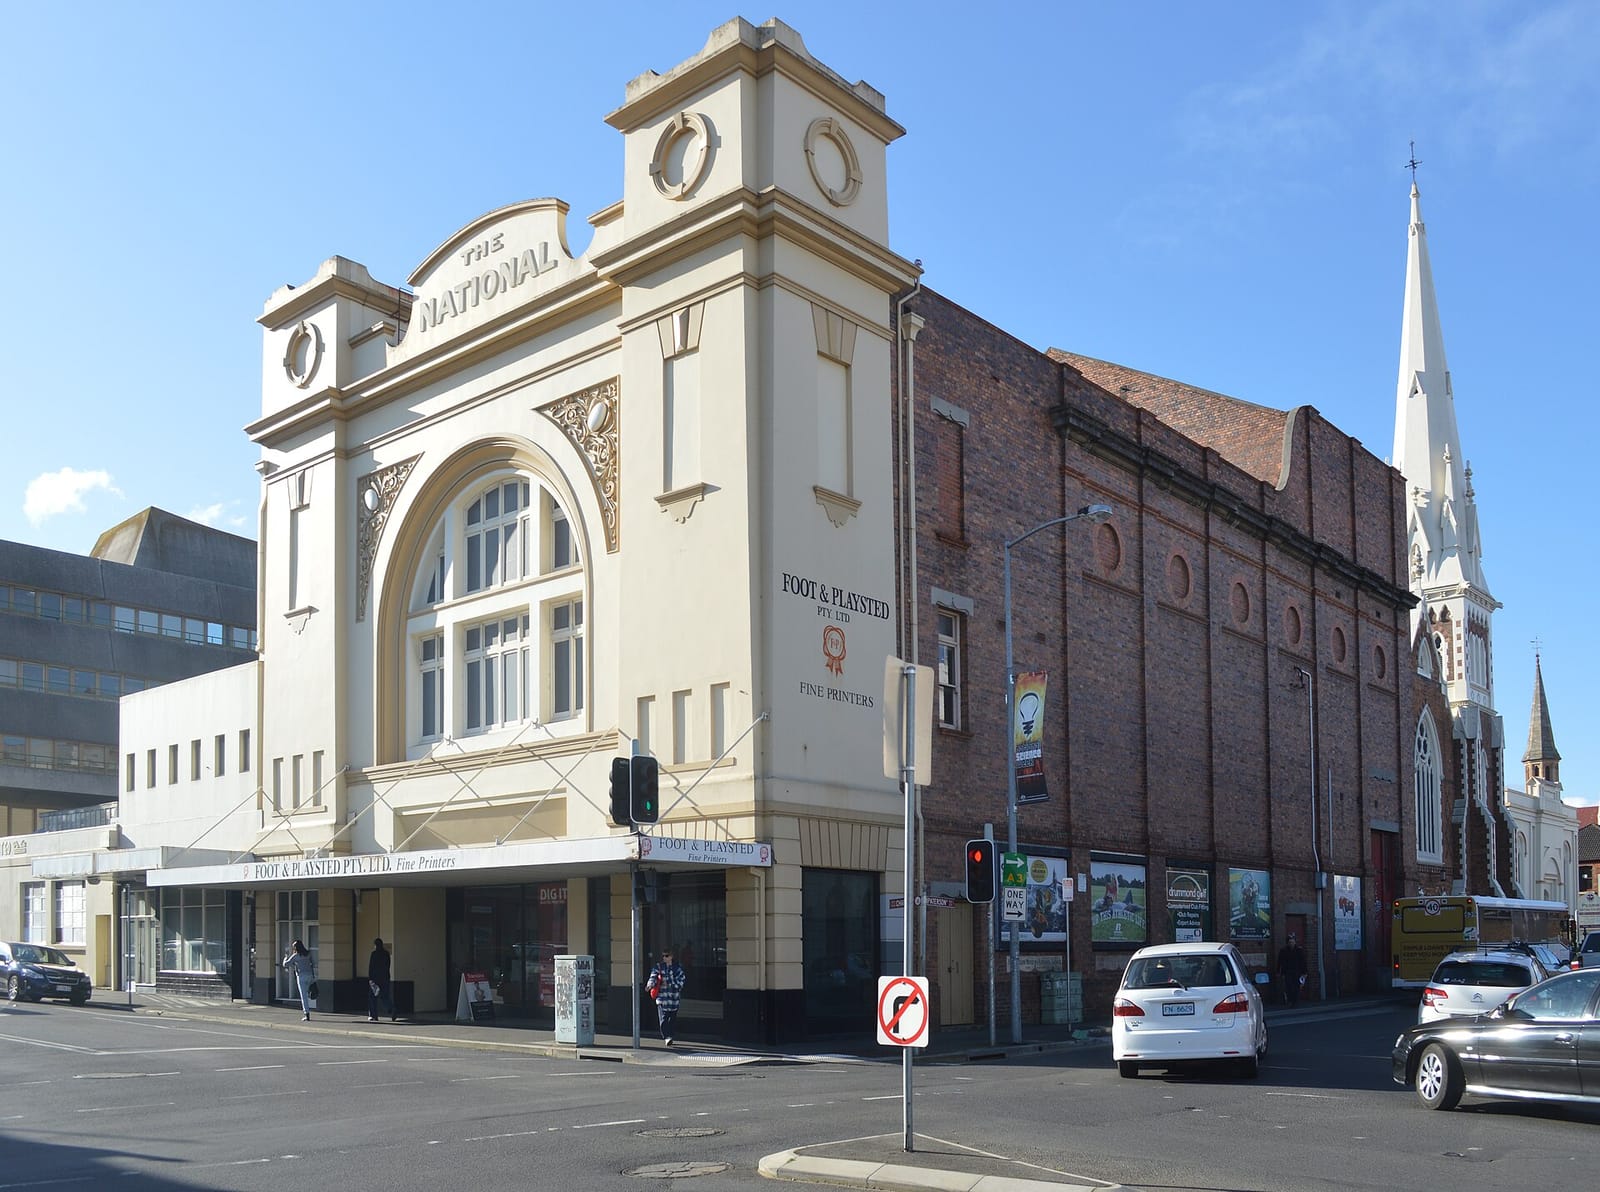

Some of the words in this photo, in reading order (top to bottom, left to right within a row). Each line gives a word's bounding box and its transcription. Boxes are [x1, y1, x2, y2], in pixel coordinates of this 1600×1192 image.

[461, 232, 504, 266] THE
[420, 241, 558, 332] NATIONAL
[782, 573, 817, 600] FOOT
[820, 584, 829, 603] &
[832, 587, 890, 620] PLAYSTED
[836, 611, 850, 624] LTD
[800, 681, 824, 698] FINE
[827, 688, 874, 708] PRINTERS
[659, 838, 688, 851] FOOT
[691, 842, 699, 851] &
[704, 842, 754, 855] PLAYSTED
[688, 853, 702, 862] Fine
[703, 854, 727, 863] Printers
[255, 864, 280, 879] FOOT
[282, 863, 290, 877] &
[292, 860, 341, 877] PLAYSTED
[343, 858, 367, 874] PTY.
[369, 857, 392, 872] LTD.
[396, 857, 415, 871] Fine
[418, 856, 456, 870] Printers
[1007, 872, 1024, 883] A3
[1007, 890, 1024, 899] ONE
[1169, 887, 1196, 898] drummond
[1197, 888, 1207, 900] golf
[1006, 901, 1024, 909] WAY
